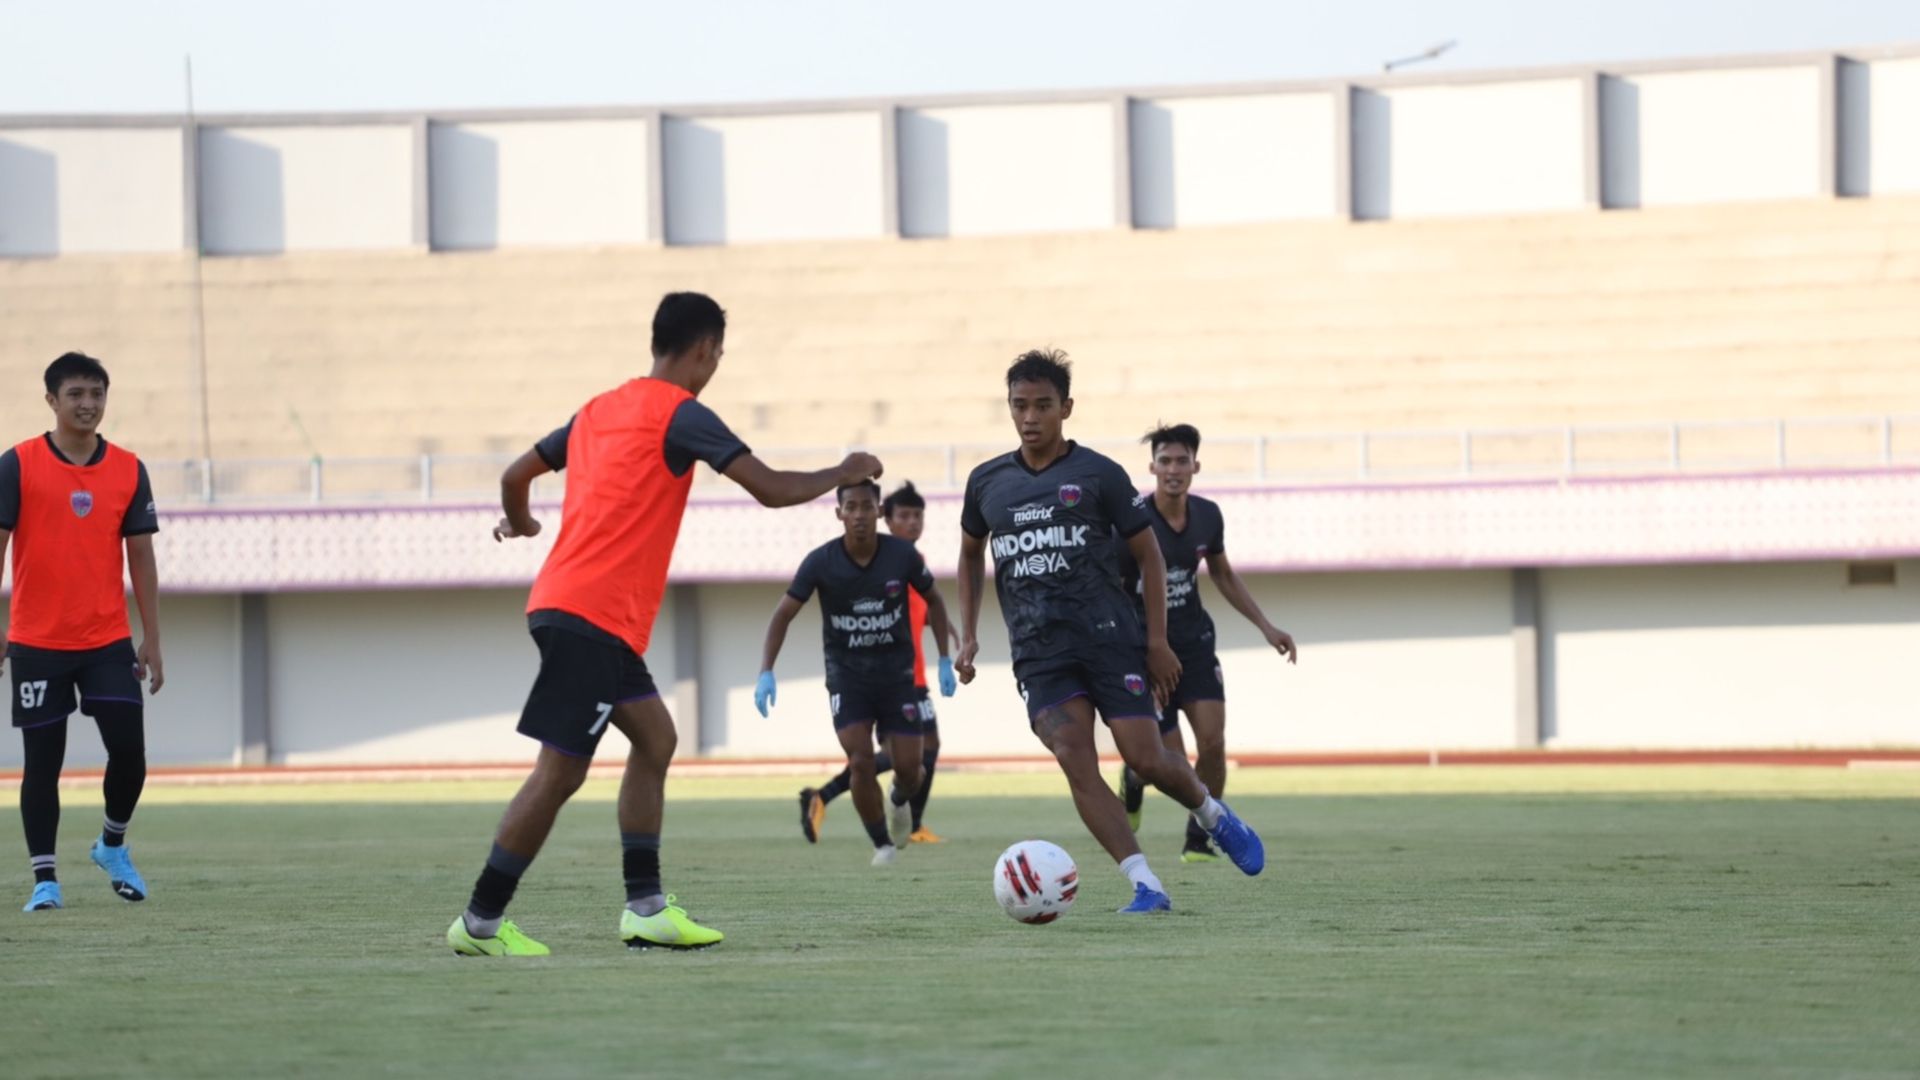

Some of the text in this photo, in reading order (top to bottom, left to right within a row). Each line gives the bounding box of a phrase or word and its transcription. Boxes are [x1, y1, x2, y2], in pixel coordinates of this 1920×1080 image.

[1013, 505, 1055, 523] matrix
[992, 525, 1087, 559] INDOMILK
[1013, 551, 1070, 578] MOYA
[830, 603, 902, 631] INDOMILK
[19, 680, 48, 709] 97
[588, 702, 613, 735] 7
